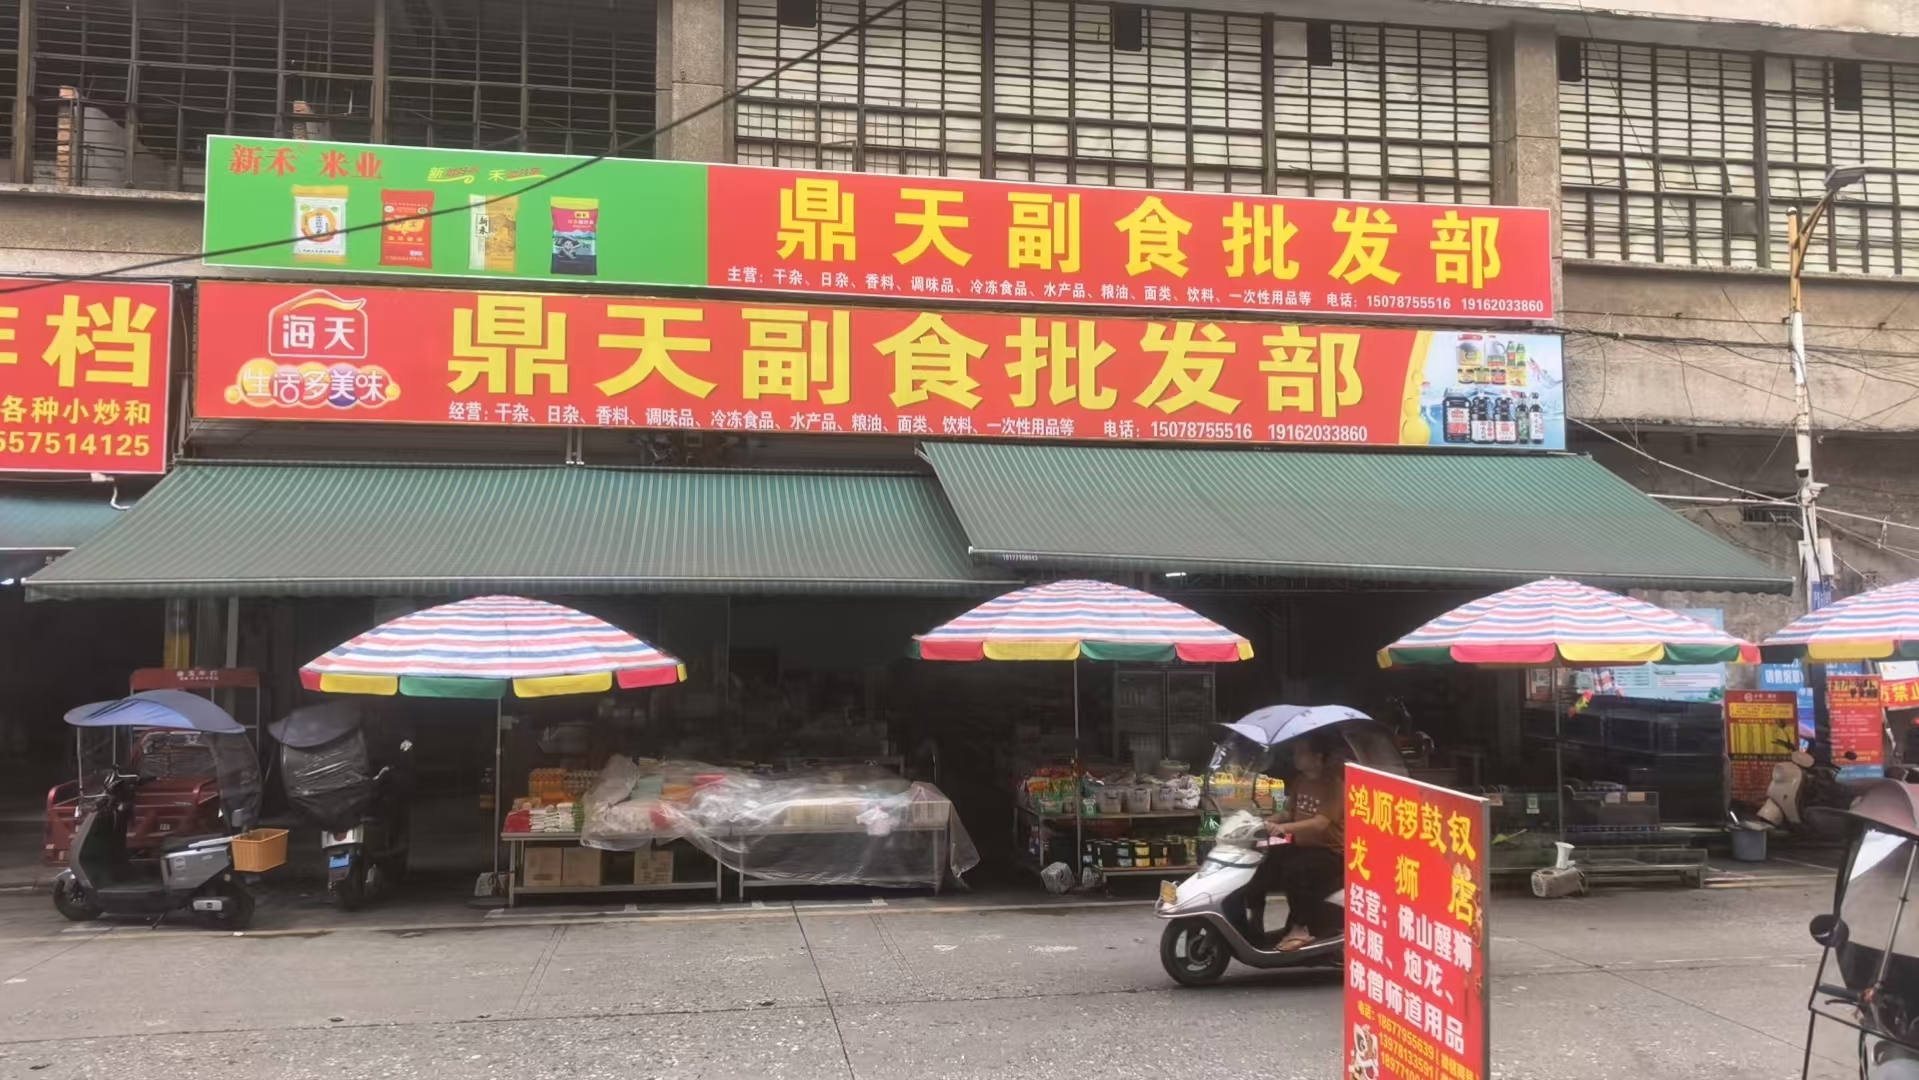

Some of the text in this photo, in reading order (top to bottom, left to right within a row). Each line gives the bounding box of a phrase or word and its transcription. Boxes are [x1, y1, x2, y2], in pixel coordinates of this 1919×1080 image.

[777, 178, 1502, 289] 鼎天副食批发部
[1461, 297, 1545, 313] 19162033860
[283, 314, 355, 350] 海天
[447, 295, 1362, 418] 鼎天副食批发部
[243, 366, 386, 404] 生活多美味
[0, 394, 152, 427] 各种小炒和
[1267, 423, 1368, 442] 19162033860
